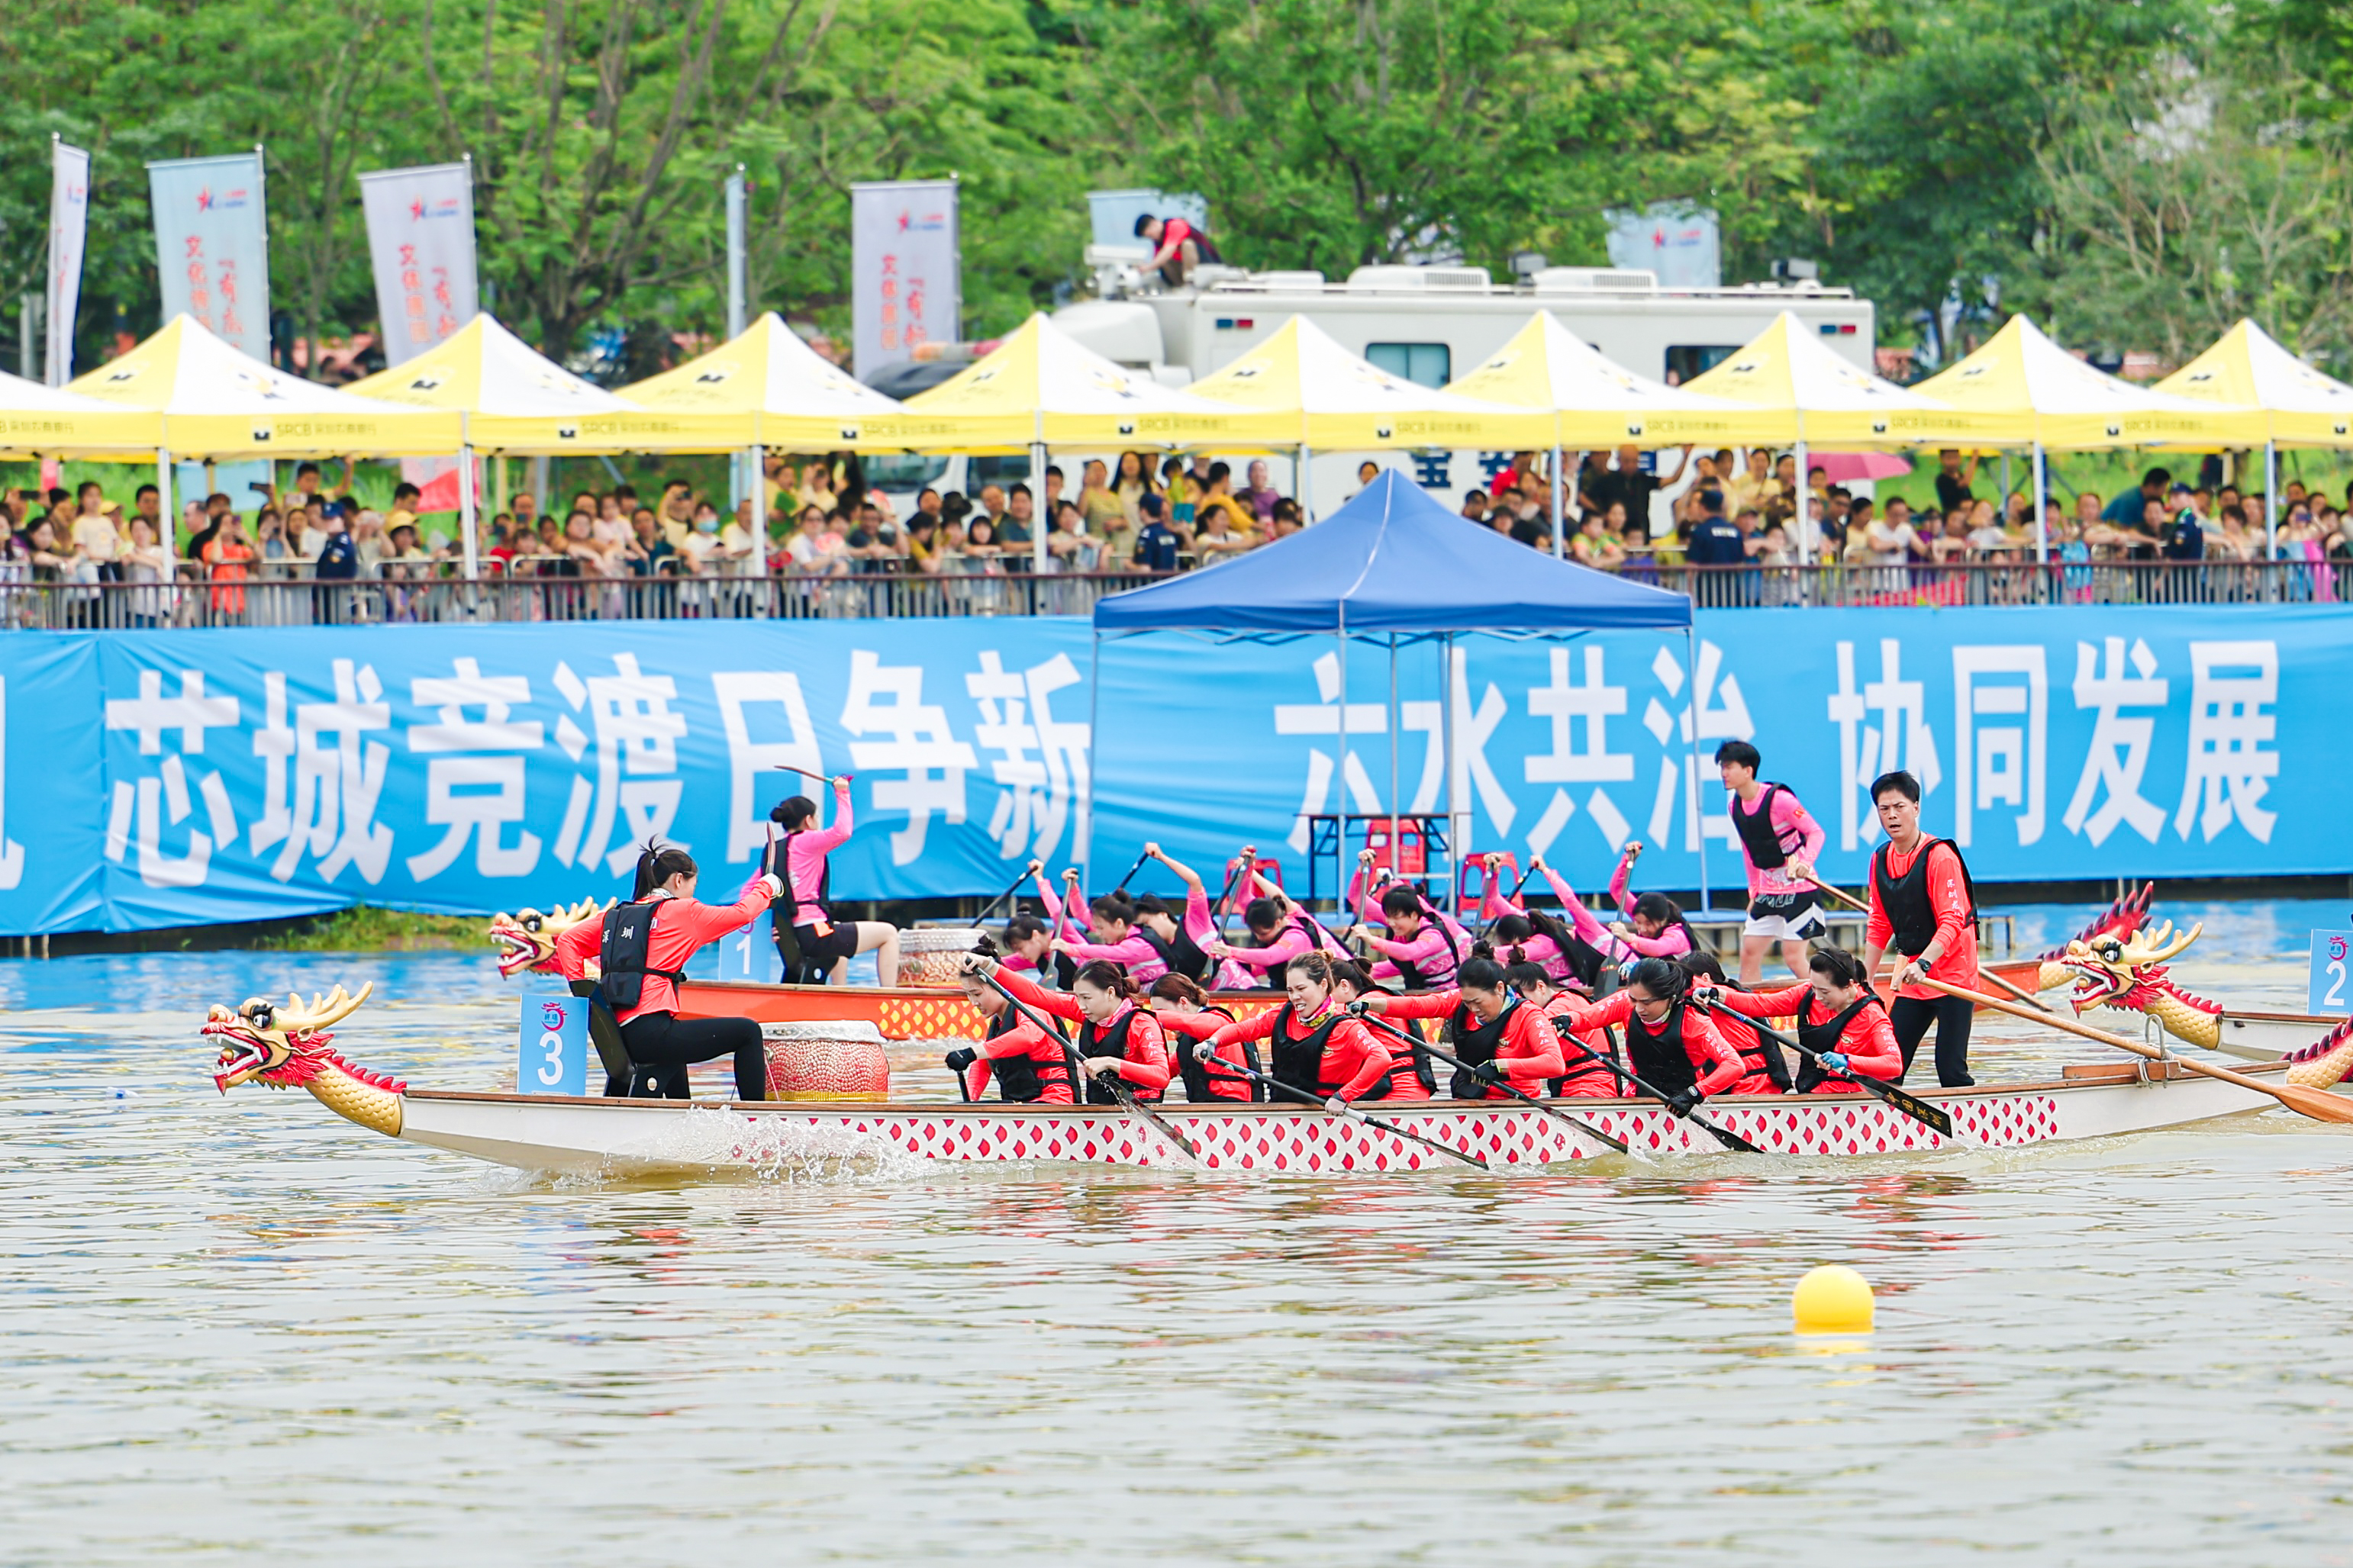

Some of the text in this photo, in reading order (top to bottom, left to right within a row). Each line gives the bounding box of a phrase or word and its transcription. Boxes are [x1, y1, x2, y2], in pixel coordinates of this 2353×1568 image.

[276, 423, 312, 436] SRCB
[105, 649, 1092, 887] 芯城竞渡日争新
[1274, 639, 1755, 861] 六水共治
[1828, 637, 2280, 852] 协同发展
[737, 935, 751, 974] 1
[2323, 961, 2347, 1006] 2
[537, 1031, 564, 1086] 3
